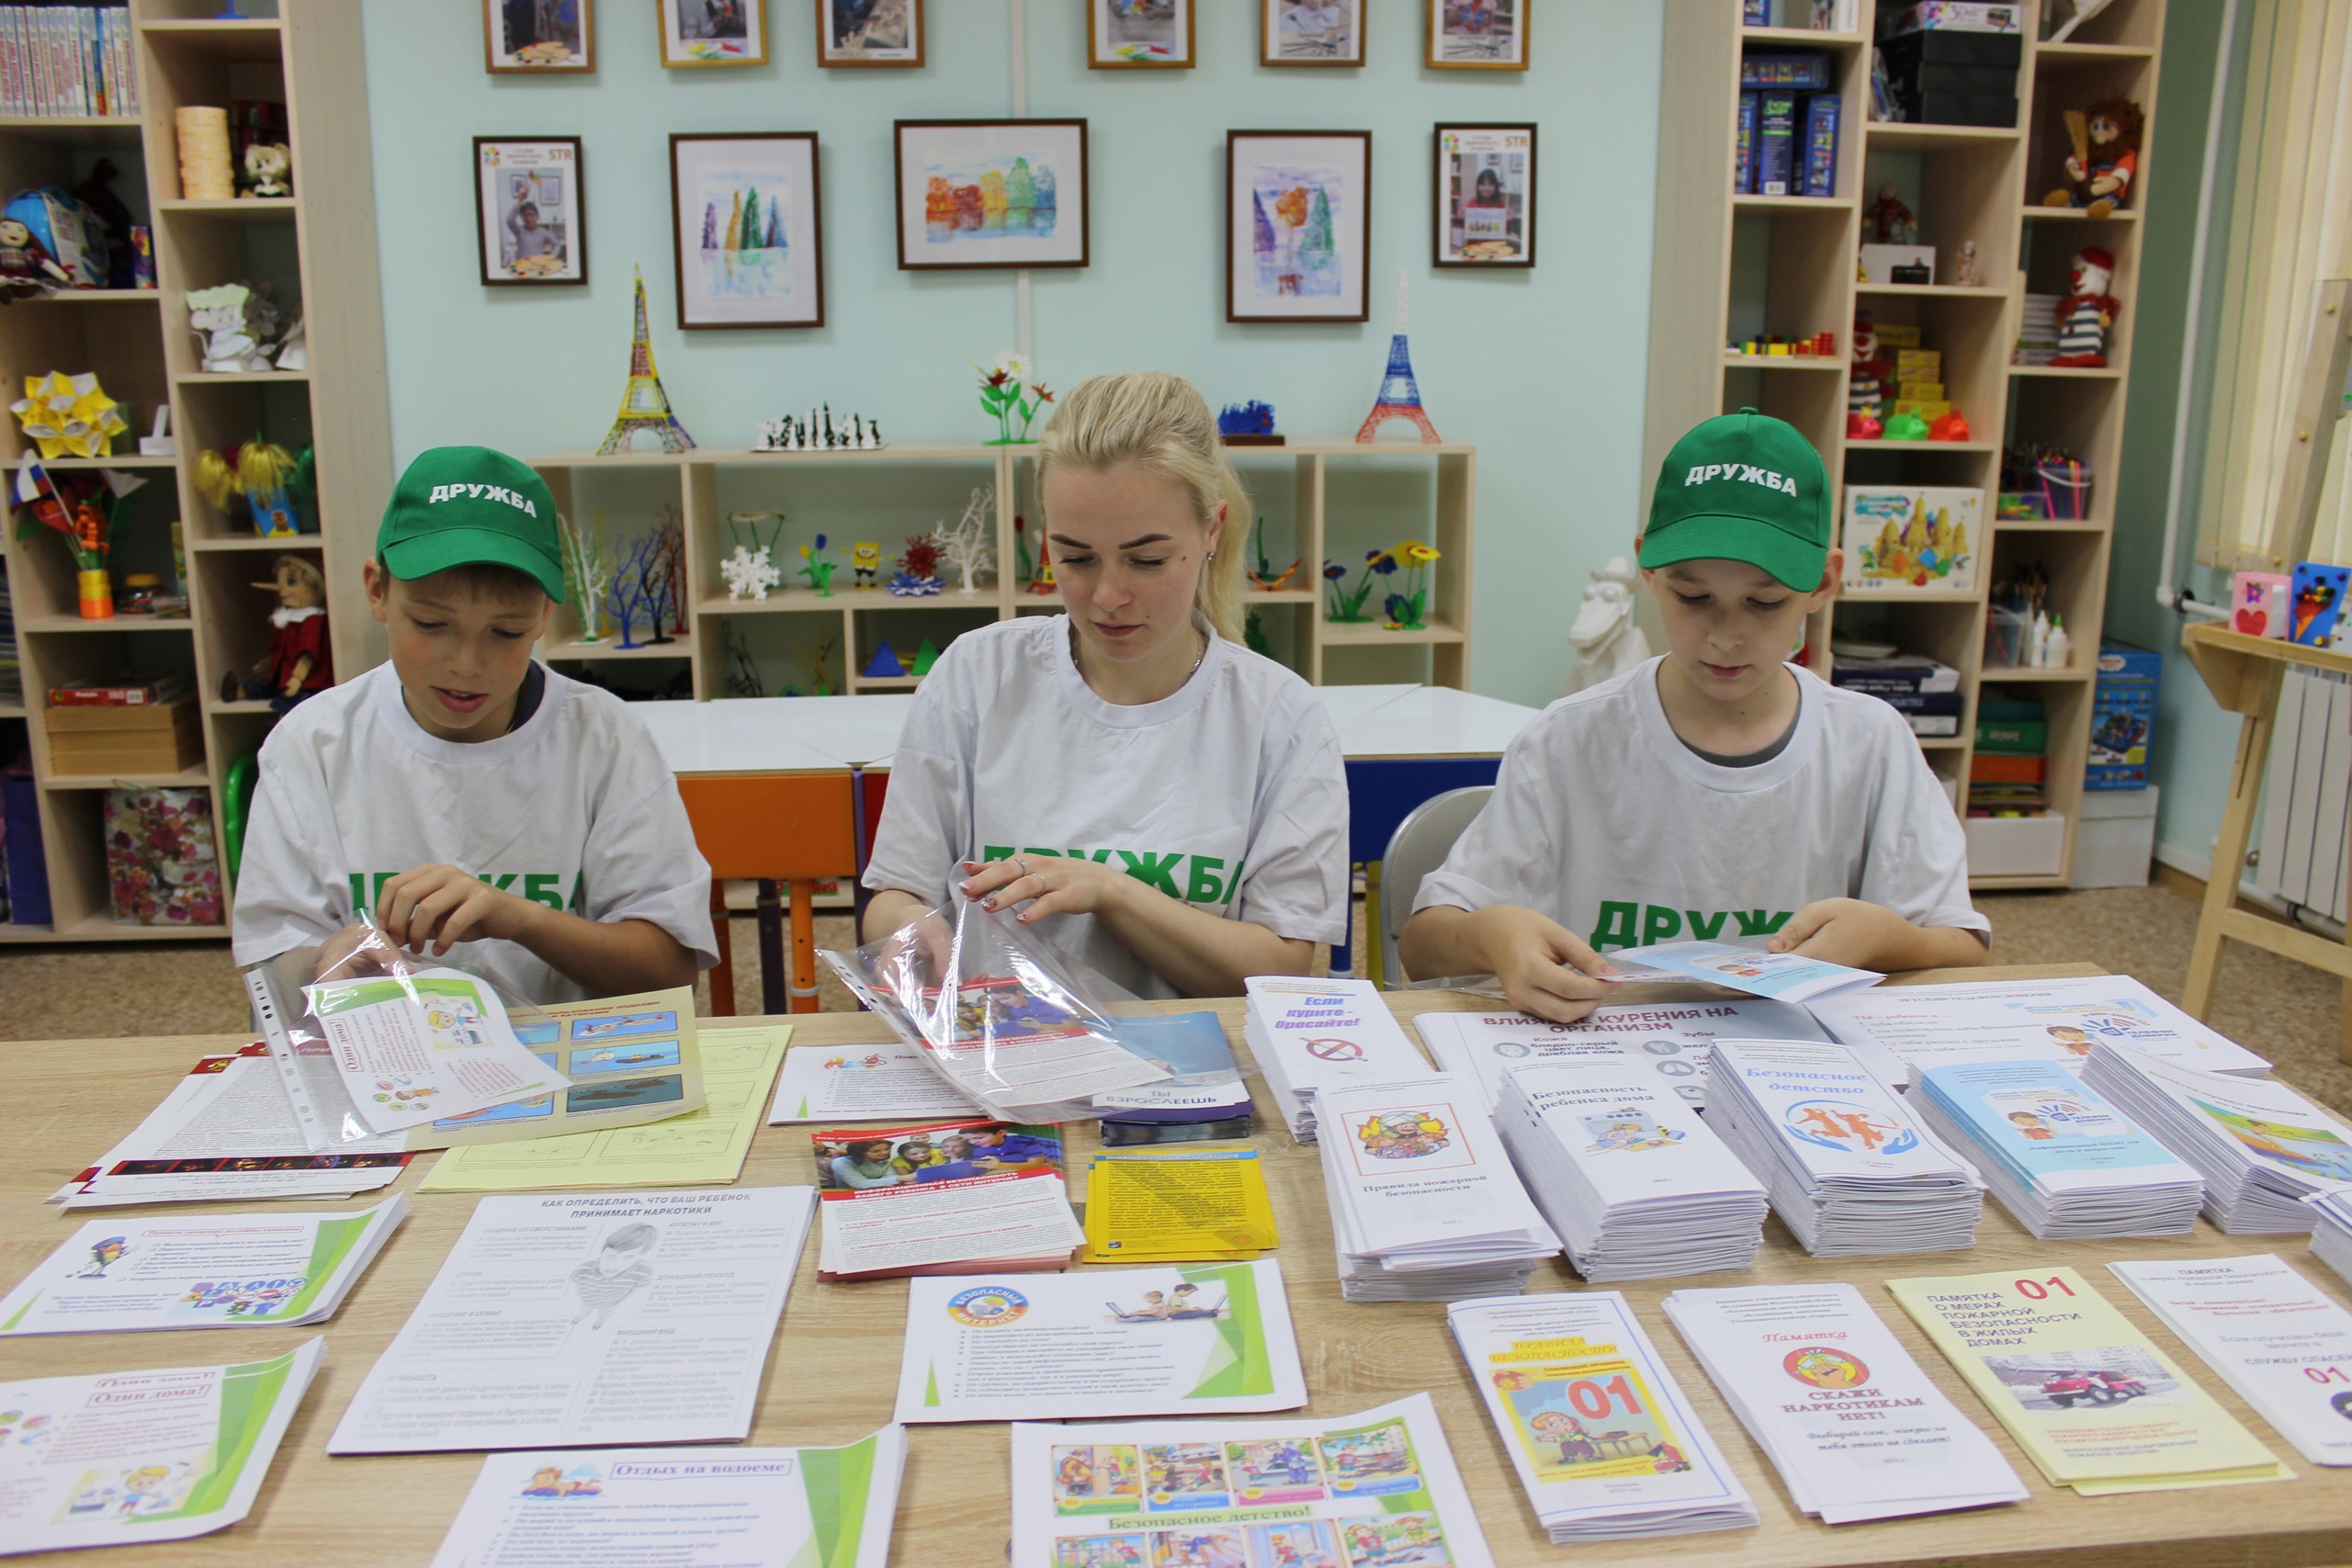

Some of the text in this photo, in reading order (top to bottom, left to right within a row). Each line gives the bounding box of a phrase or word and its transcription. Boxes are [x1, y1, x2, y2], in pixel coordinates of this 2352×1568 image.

[1505, 136, 1528, 148] STR
[548, 149, 572, 161] STR
[1684, 463, 1797, 497] ДРУЖБА
[429, 483, 537, 518] ДРУЖБА
[1589, 900, 1795, 953] ДРУЖ
[1286, 1010, 1344, 1018] курите
[1483, 1006, 1739, 1026] ВЛИЯЕ КУРЕНИЯ НА
[1275, 1018, 1361, 1029] бросайте!
[1549, 1022, 1674, 1033] ОРГАНИЗМ
[1531, 1040, 1619, 1048] бледно-серый
[343, 1046, 359, 1069] Один
[1747, 1068, 1868, 1081] Безопасное
[1532, 1086, 1647, 1100] Безопасность
[1769, 1082, 1865, 1094] детство
[1106, 1096, 1217, 1105] ВЗРОСЛЕЕШЬ
[1538, 1094, 1655, 1111] ребенка дома
[854, 1171, 1019, 1196] ИНФОРМАЦИОННАЯ БЕЗОПАСНОСТЬ
[895, 1185, 936, 1197] РЕБЕНКА
[947, 1180, 973, 1190] СЕТИ
[975, 1175, 1020, 1187] ИНТЕРНЕТ
[1363, 1176, 1487, 1192] Правила пожарной
[1385, 1184, 1471, 1198] безопасности
[540, 1200, 565, 1208] КАК
[565, 1197, 645, 1207] ОПРЕДЕЛИТЬ,
[647, 1196, 670, 1205] ЧТО
[671, 1195, 695, 1204] ВАШ
[570, 1206, 713, 1219] ПРИНИМАЕТ НАРКОТИКИ
[528, 1224, 588, 1233] СВЕРСТНИКАМИ
[656, 1271, 736, 1281] ДОМАШНИЙ ОБИХОД
[2177, 1268, 2235, 1276] ПАМЯТКА
[2014, 1277, 2076, 1300] 01
[956, 1288, 1023, 1306] БЕЗОПАСНЫЙ
[1927, 1292, 2004, 1303] ПАМЯТКА
[1951, 1301, 2006, 1311] МЕРАХ
[956, 1311, 1021, 1325] ИНТЕРНЕТ
[1941, 1307, 2036, 1319] ПОЖАРНОЙ
[1950, 1313, 2082, 1328] БЕЗОПАСНОСТИ
[616, 1328, 658, 1337] ВНЕШНИЙ
[1761, 1331, 1849, 1343] Памятка
[1976, 1327, 2038, 1337] ЖИЛЫХ
[1512, 1337, 1586, 1350] ПРАВИЛА
[1966, 1337, 2027, 1348] ДОМАХ
[1491, 1344, 1618, 1363] БЕЗОПАСНОСТИ
[2245, 1357, 2298, 1365] СЛУЖБУ
[2303, 1366, 2351, 1383] 01
[94, 1387, 205, 1404] Один дома!
[1566, 1374, 1644, 1420] 01
[1808, 1388, 1883, 1400] СКАЖИ
[1781, 1397, 1927, 1413] НАРКОТИКАМ
[1836, 1411, 1886, 1422] НЕТ!
[1806, 1430, 1860, 1440] Выбирай
[1894, 1427, 1931, 1435] никто
[1818, 1442, 1849, 1451] тебя
[1850, 1441, 1884, 1450] этого
[1903, 1435, 1951, 1446] сделает!
[616, 1461, 786, 1477] Отдых на водоеме
[1108, 1506, 1312, 1531] Безопасное детство!
